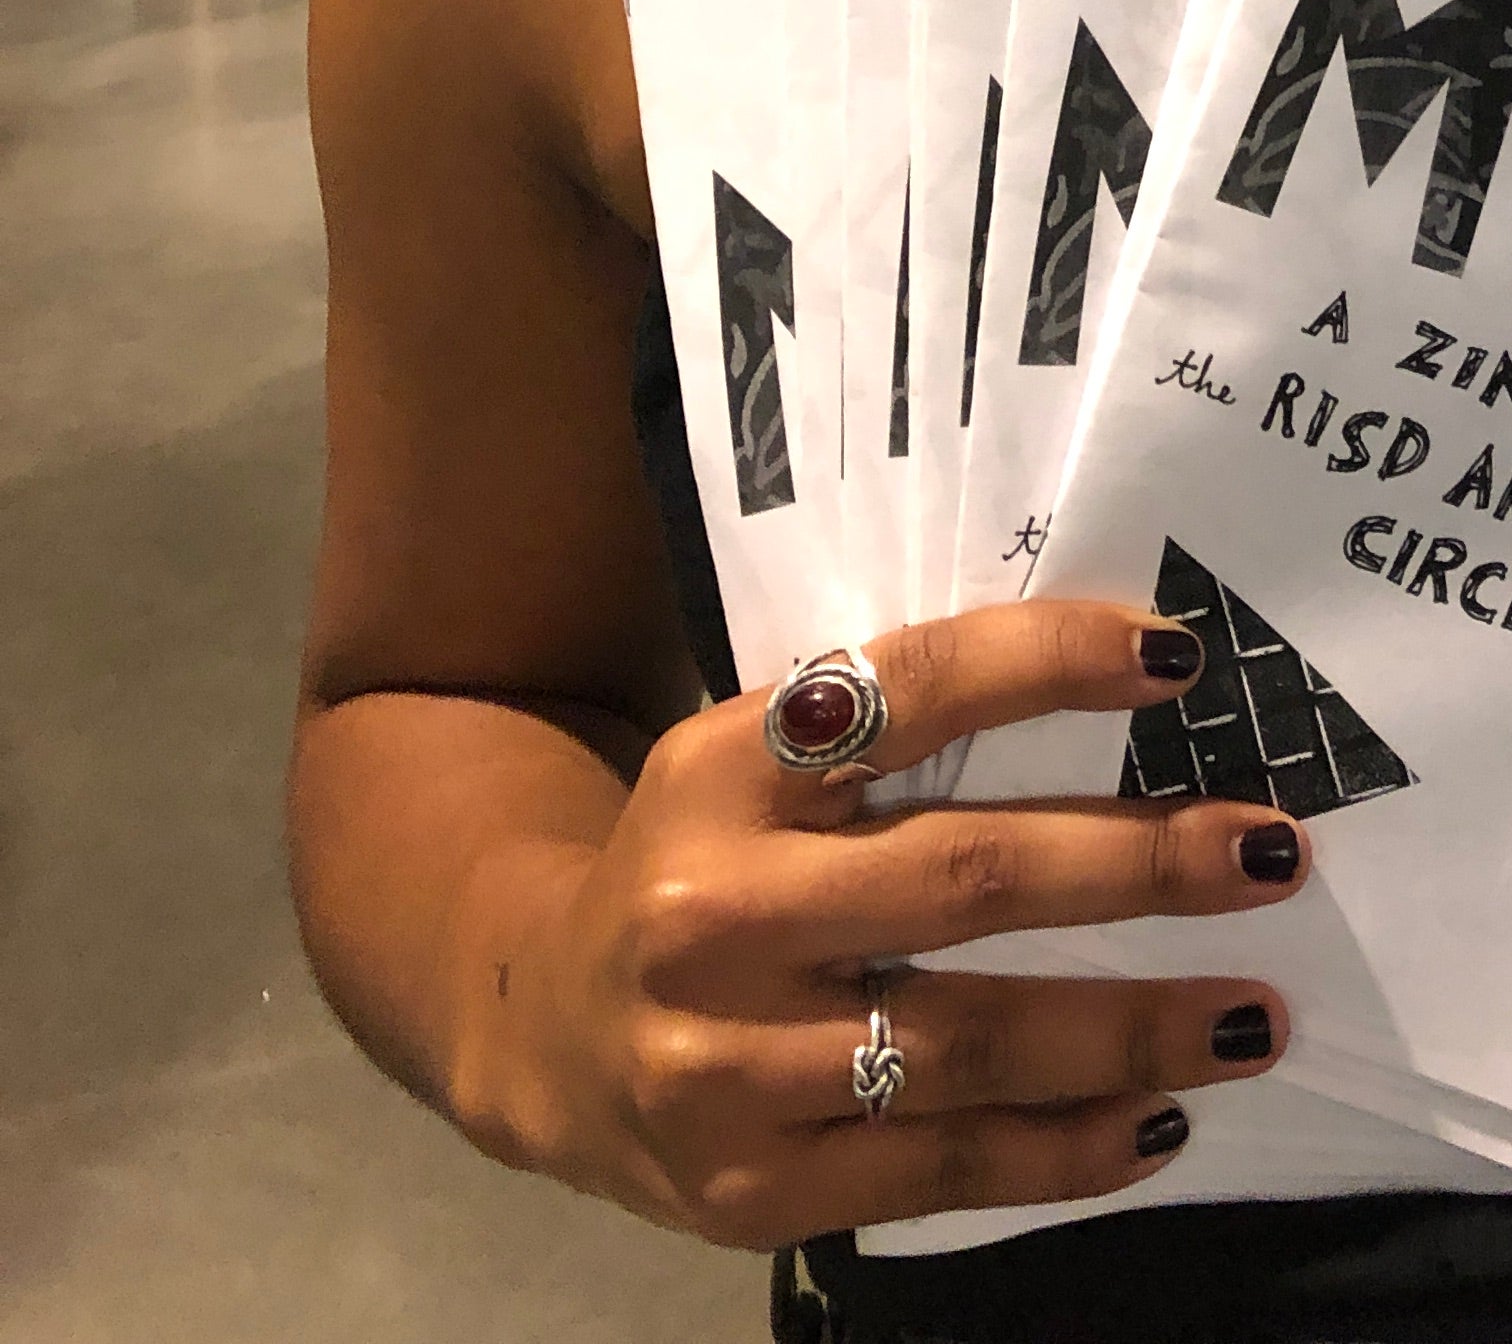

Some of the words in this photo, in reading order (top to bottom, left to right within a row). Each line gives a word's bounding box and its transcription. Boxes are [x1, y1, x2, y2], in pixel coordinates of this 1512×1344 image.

[1301, 290, 1349, 345] A
[1155, 349, 1236, 406] the
[1260, 372, 1431, 482] RISD
